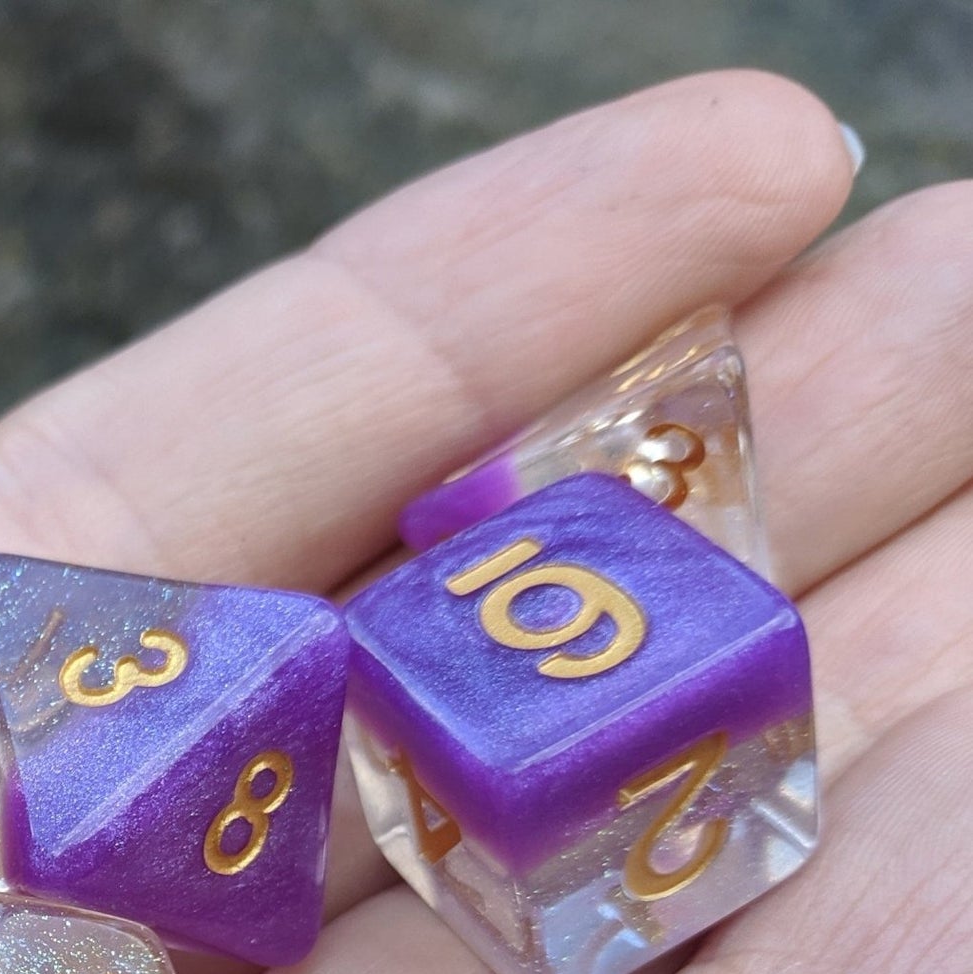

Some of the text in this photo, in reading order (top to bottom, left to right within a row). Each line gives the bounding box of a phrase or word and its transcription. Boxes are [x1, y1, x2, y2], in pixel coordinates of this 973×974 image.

[59, 628, 188, 708] 3
[204, 749, 295, 876] 8
[619, 731, 729, 900] 2
